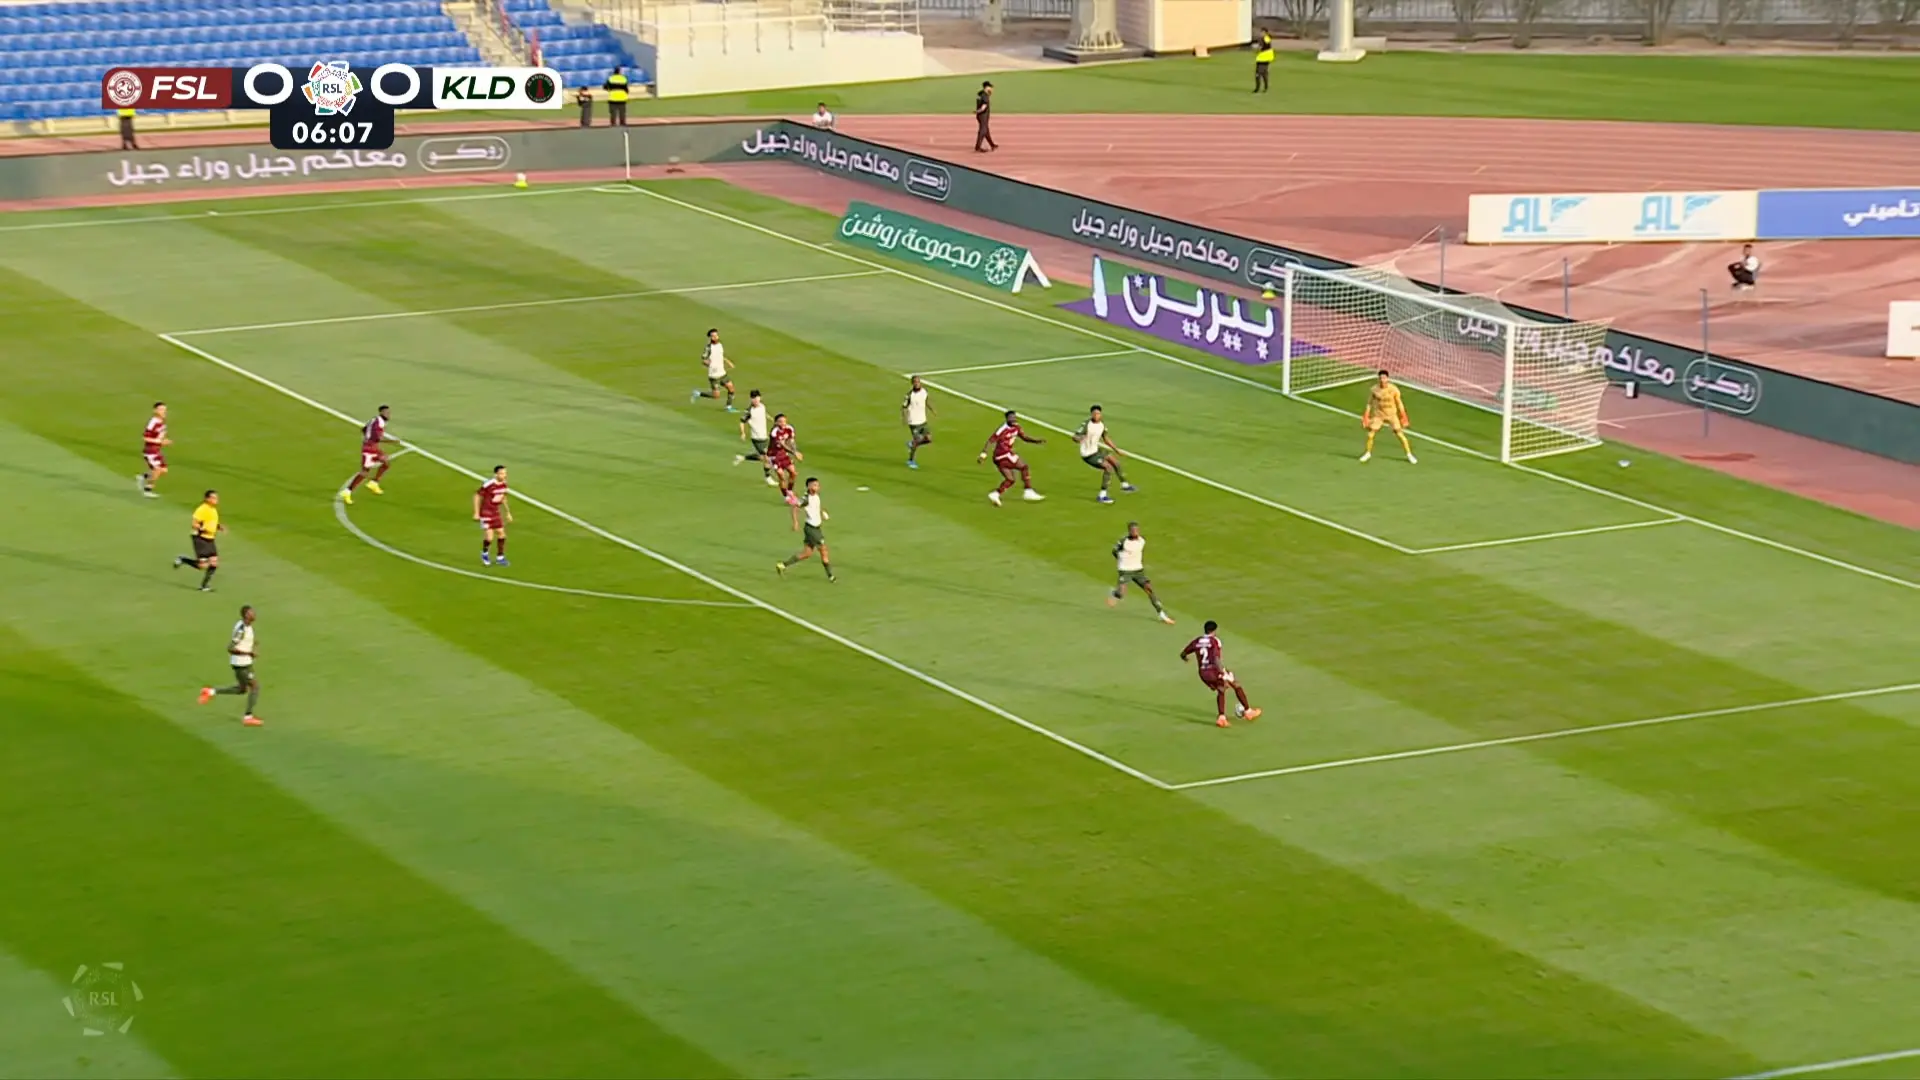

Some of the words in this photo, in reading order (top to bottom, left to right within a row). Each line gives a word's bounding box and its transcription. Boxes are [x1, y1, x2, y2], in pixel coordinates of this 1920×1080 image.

[742, 129, 791, 154] جيل
[792, 133, 818, 161] وراء
[819, 141, 848, 169] جيل
[107, 159, 170, 187] جيل
[176, 155, 231, 182] وراء
[235, 152, 297, 180] جيل
[302, 149, 407, 175] معاكم
[848, 152, 901, 183] معاكم
[842, 213, 902, 249] روشن
[1072, 208, 1106, 238] جيل
[1108, 218, 1138, 248] وراء
[901, 227, 982, 269] مجموعة
[1140, 226, 1175, 256] جيل
[1175, 239, 1240, 272] معاكم
[1122, 274, 1276, 360] بيرين
[1592, 345, 1676, 386] معاكم
[1199, 647, 1210, 665] 2
